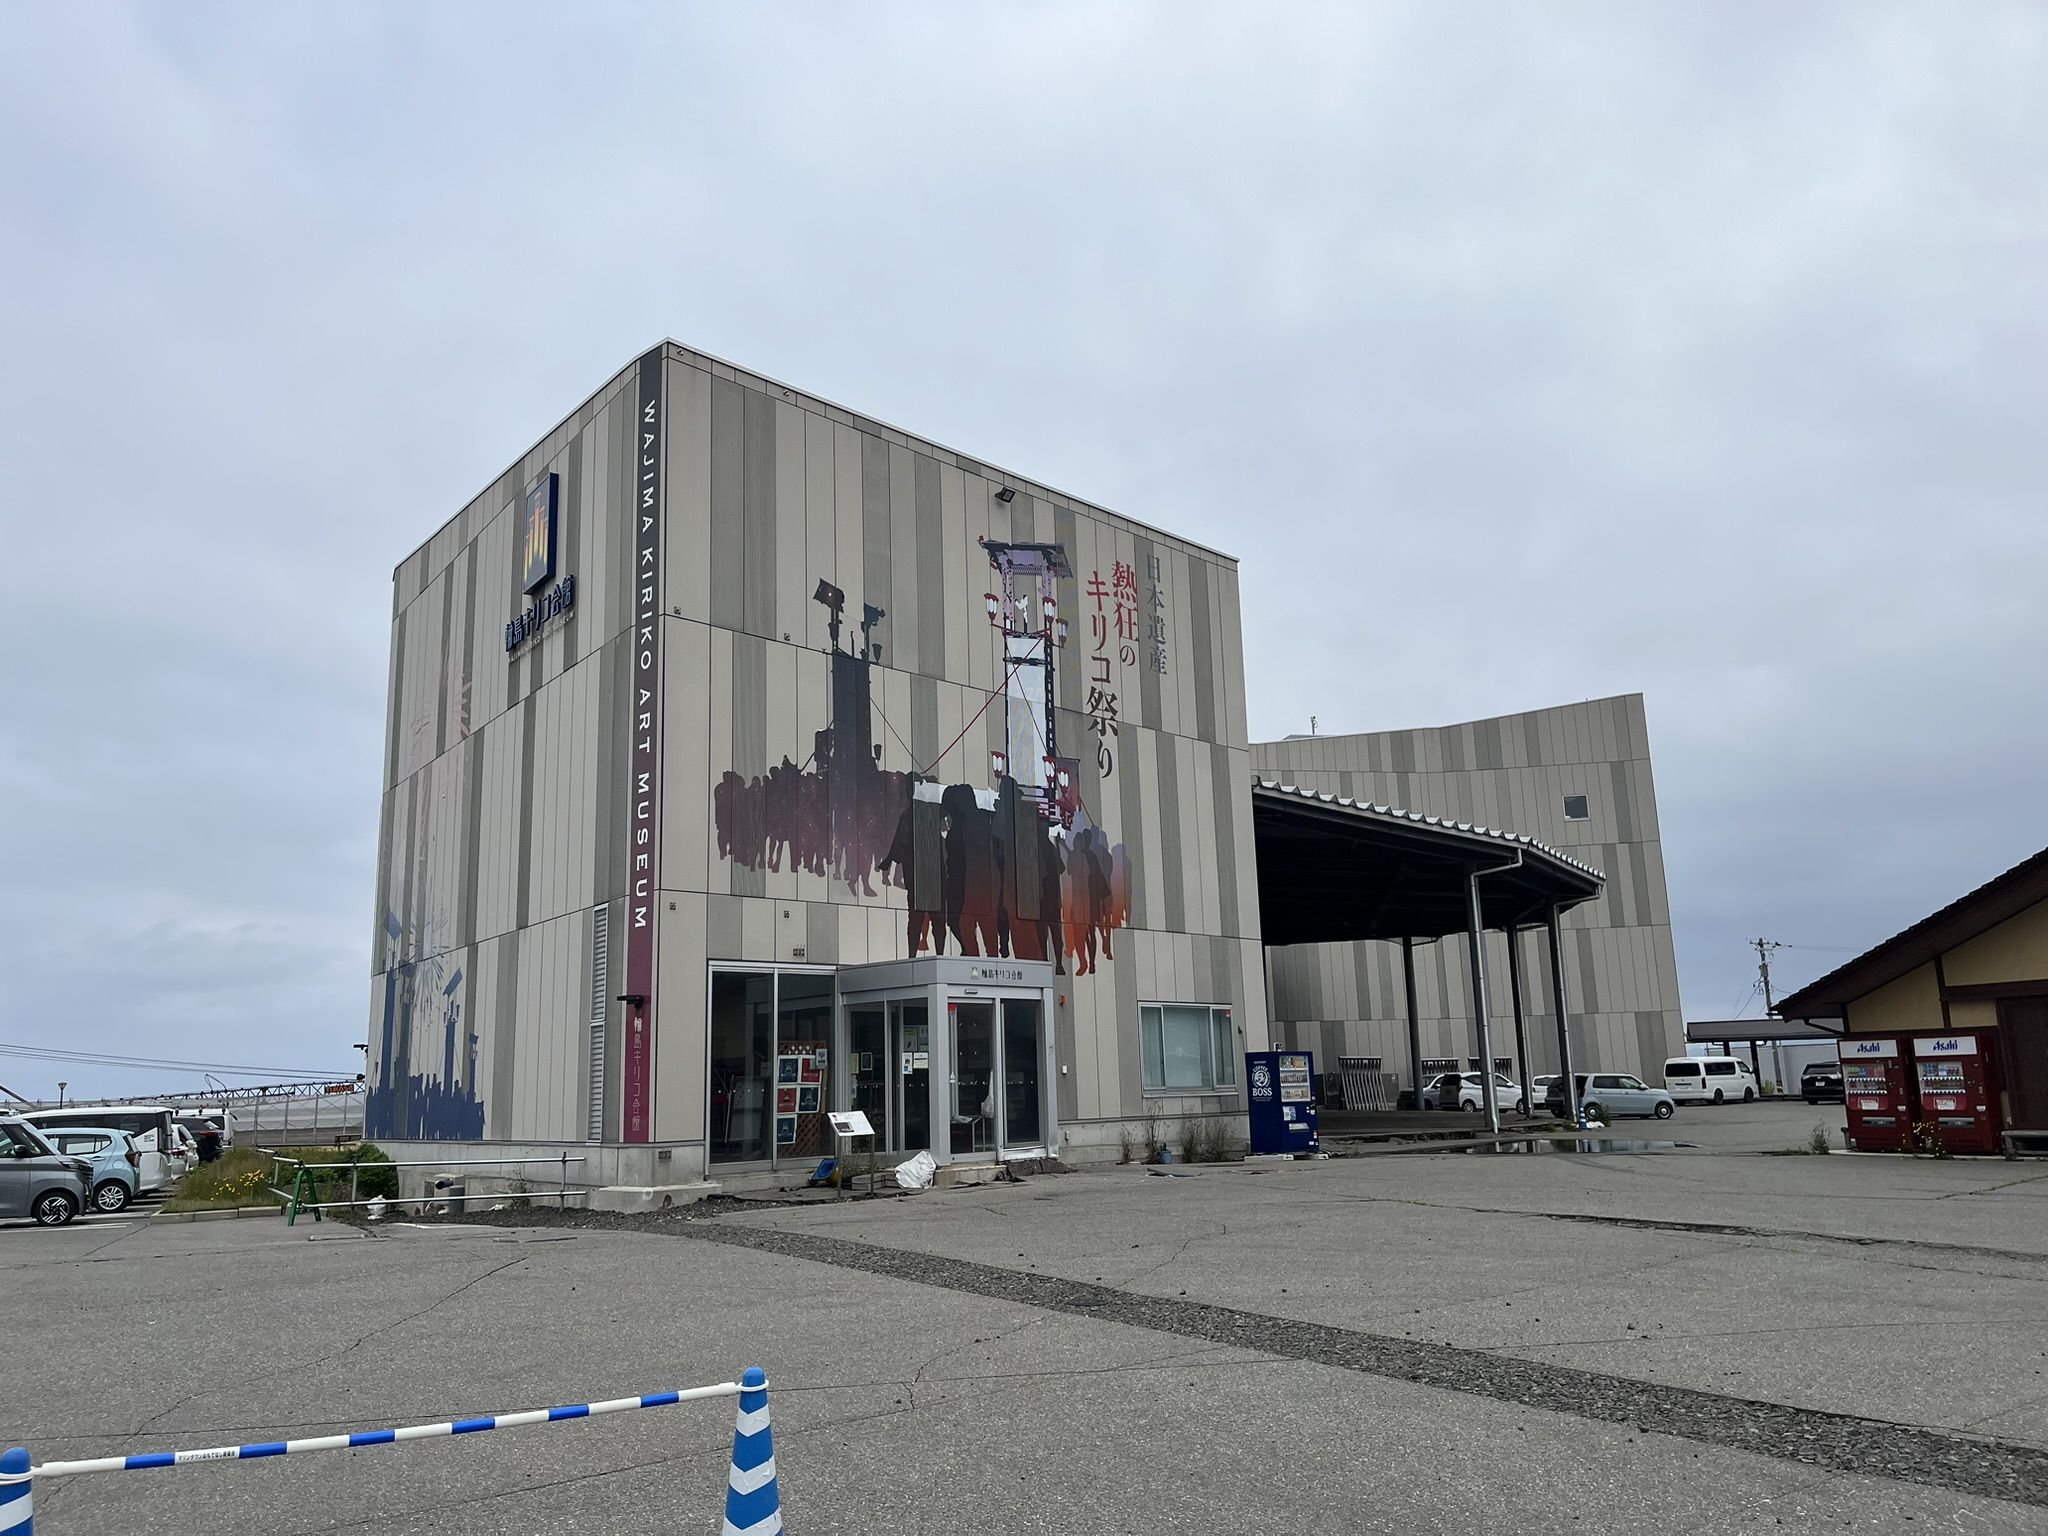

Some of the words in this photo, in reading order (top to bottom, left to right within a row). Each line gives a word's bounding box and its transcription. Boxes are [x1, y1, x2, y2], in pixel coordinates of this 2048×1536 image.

[642, 399, 656, 533] WAJIMA
[640, 547, 654, 670] KIRIKO
[1112, 560, 1140, 666] 熱狂の
[1146, 552, 1168, 675] 日本遺産
[638, 688, 651, 753] ART
[1086, 570, 1118, 779] キリコ祭り
[634, 772, 650, 928] MUSEUM
[1252, 1087, 1273, 1096] BOSS
[1857, 1042, 1880, 1053] Asahi
[1932, 1039, 1958, 1051] Asahi
